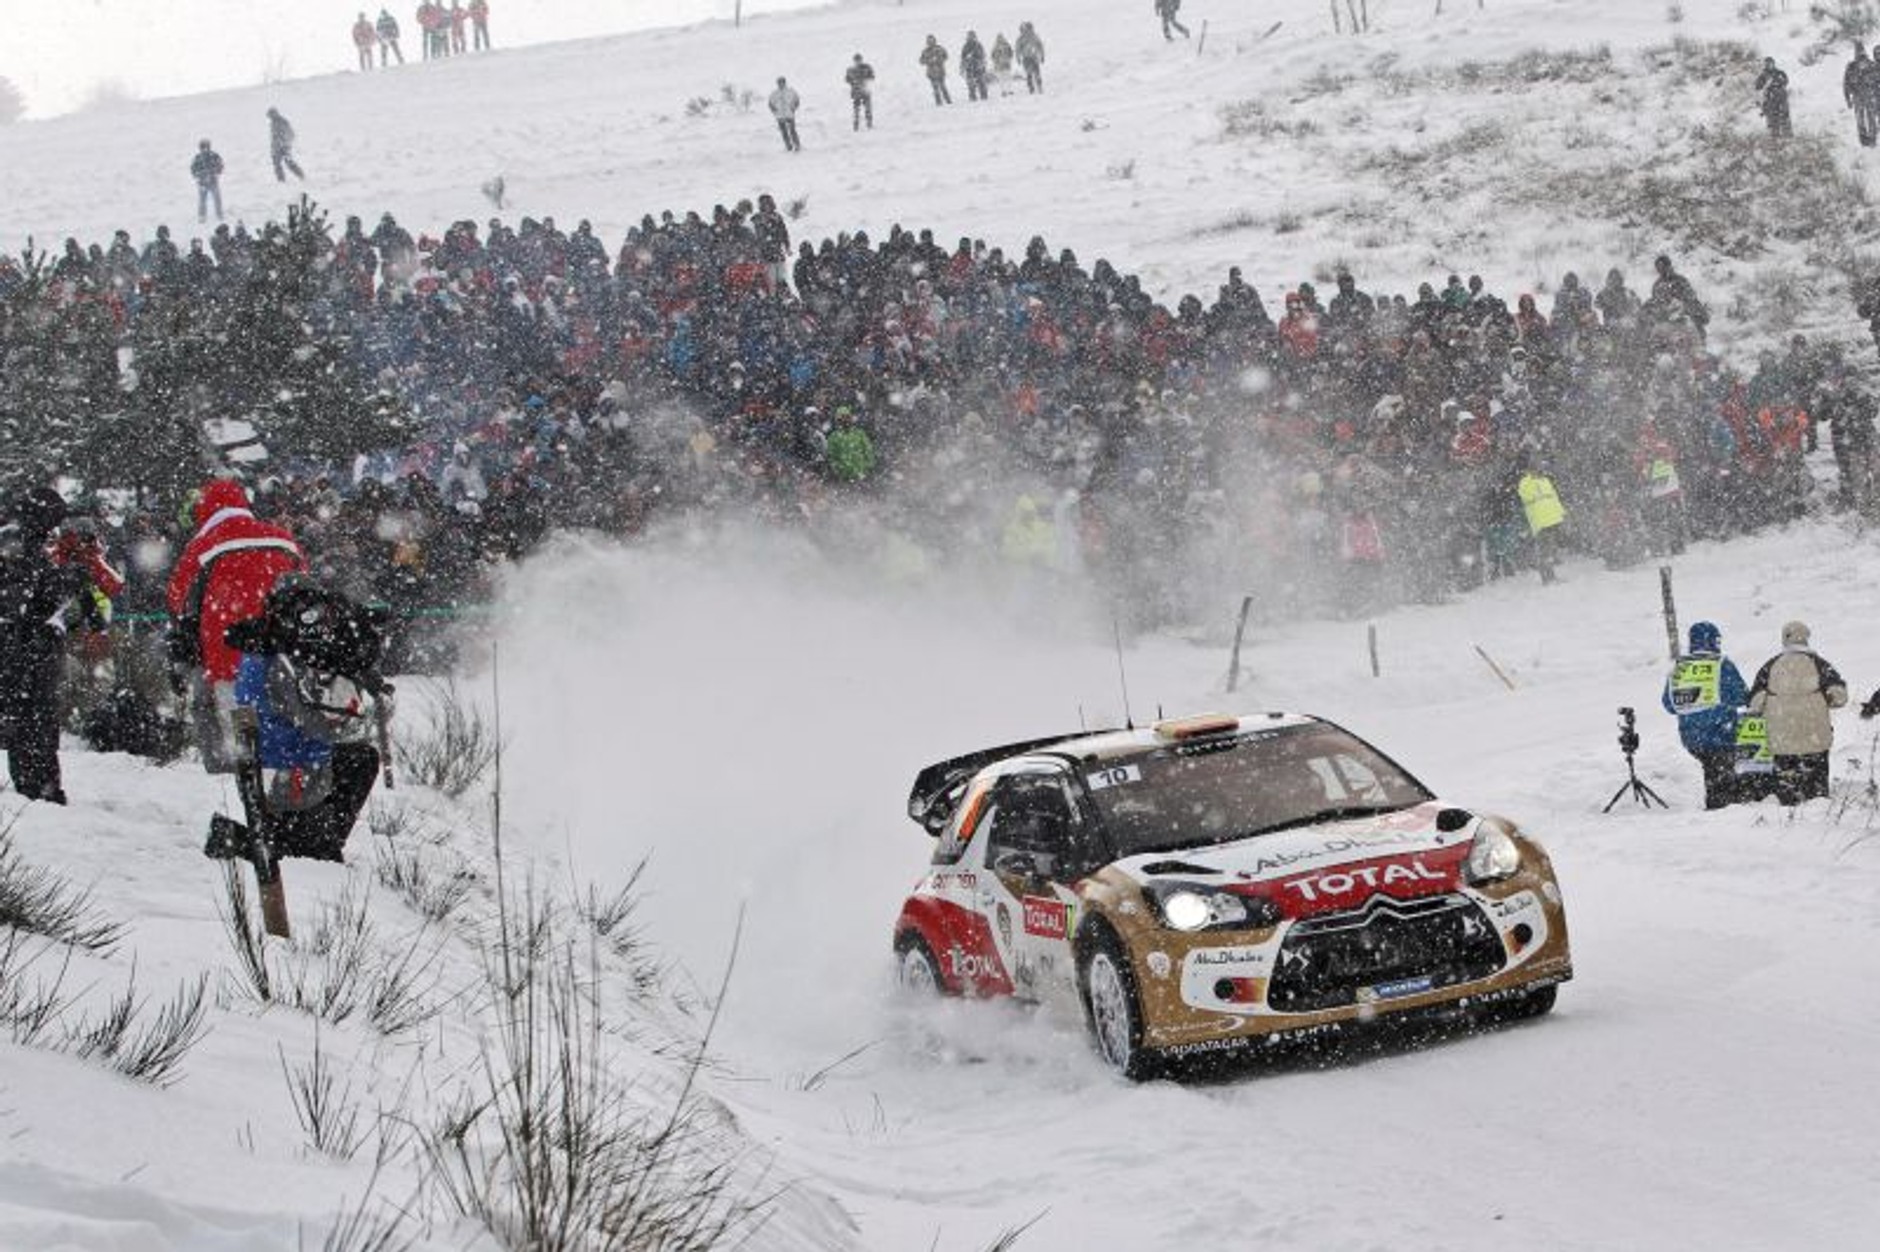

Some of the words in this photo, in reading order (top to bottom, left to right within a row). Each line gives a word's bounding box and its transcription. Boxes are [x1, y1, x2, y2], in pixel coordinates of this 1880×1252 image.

[1100, 767, 1128, 784] 10
[1284, 861, 1446, 900] TOTAL
[1025, 903, 1062, 931] TOTAL
[947, 945, 1002, 979] TOTAL
